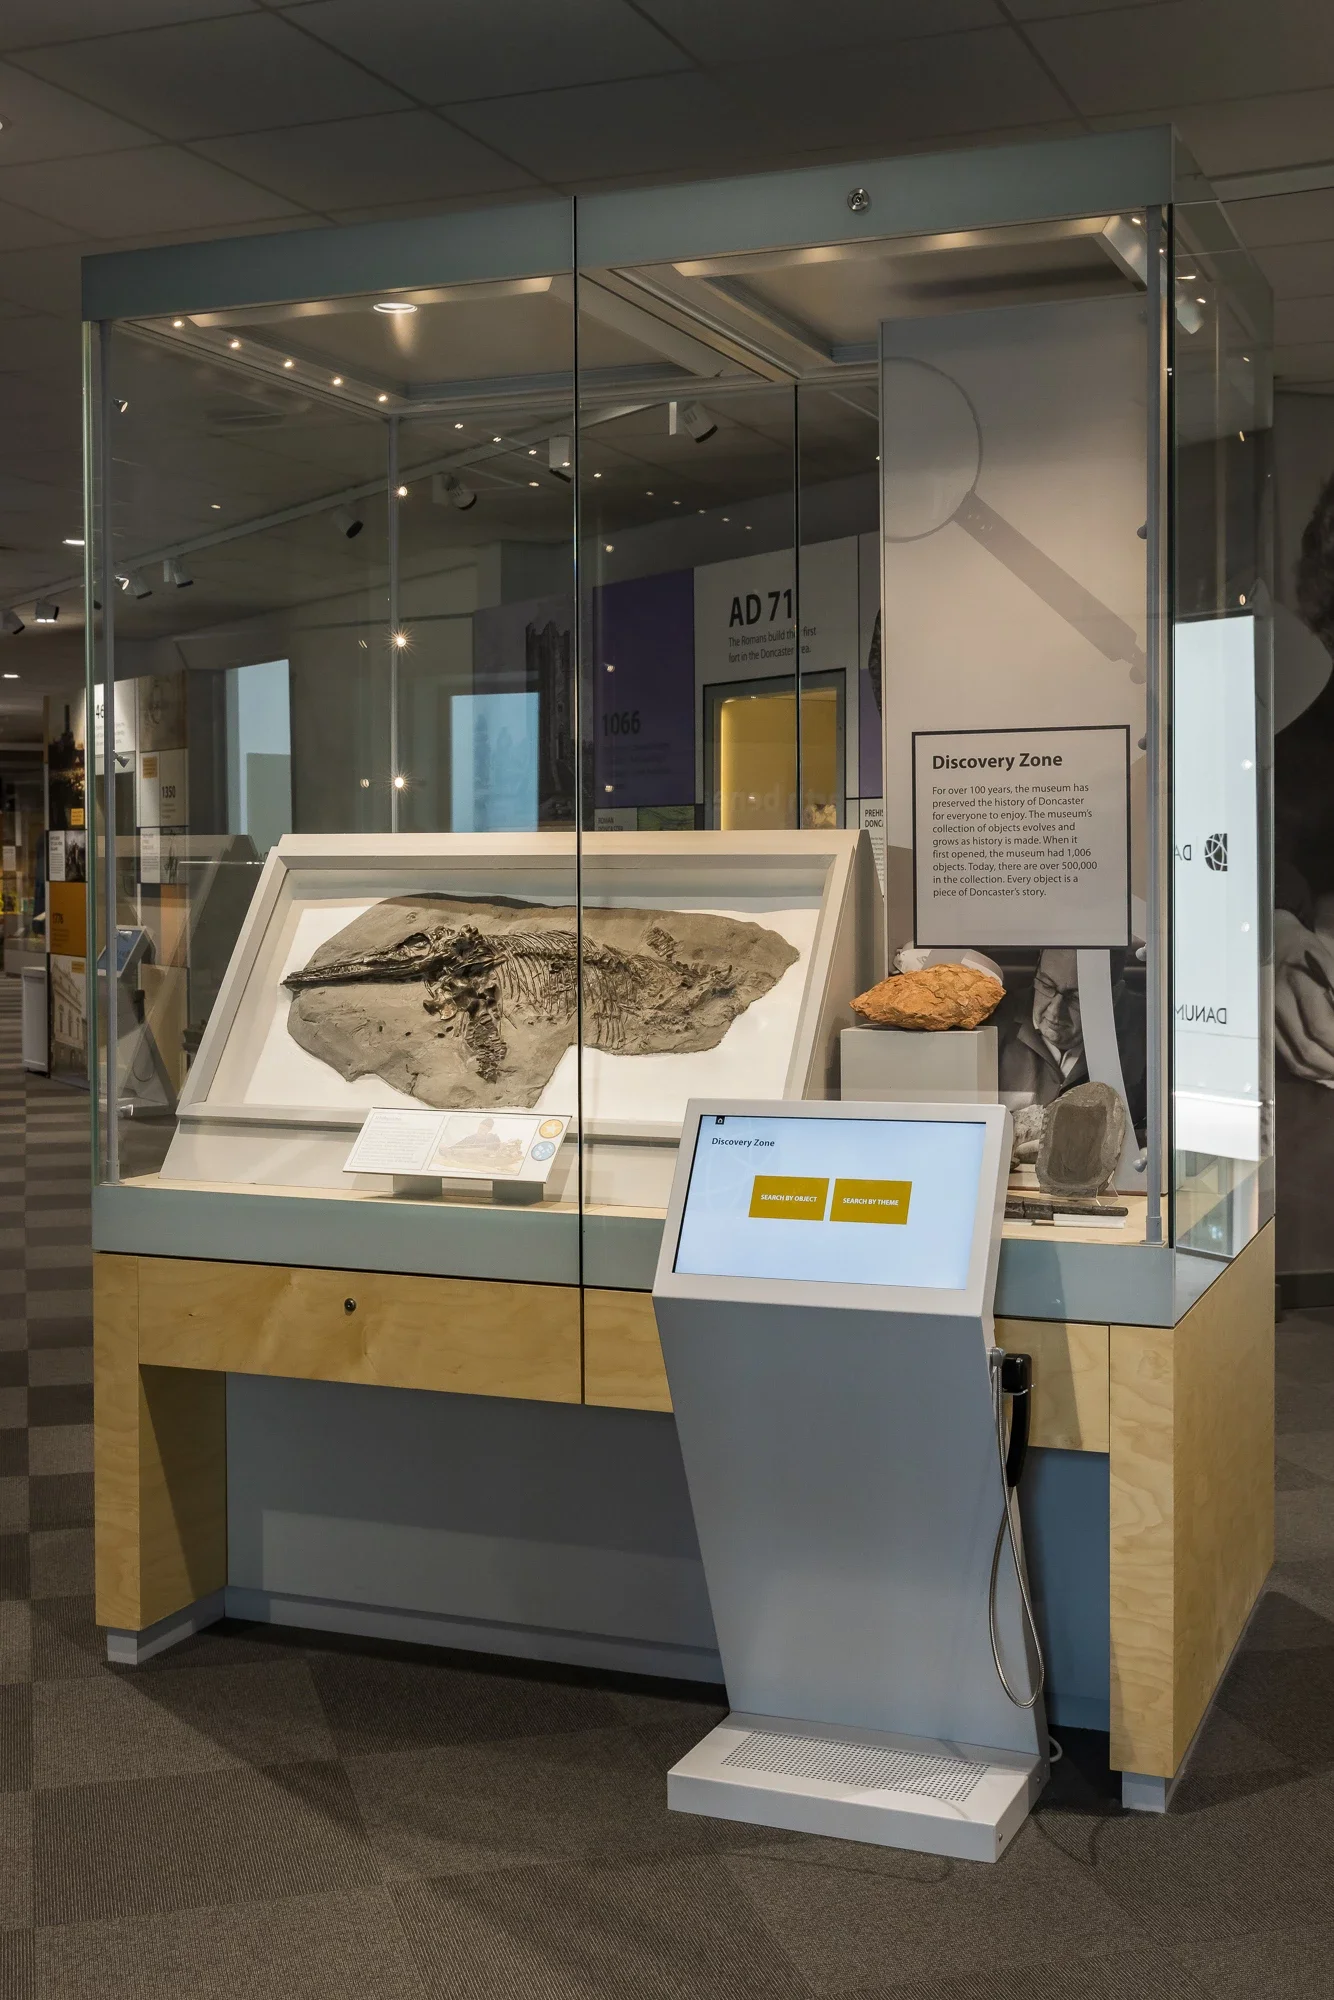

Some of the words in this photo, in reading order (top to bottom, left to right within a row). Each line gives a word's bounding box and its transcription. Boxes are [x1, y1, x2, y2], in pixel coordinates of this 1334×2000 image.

[729, 594, 761, 627] AD
[768, 589, 792, 621] 71
[729, 638, 740, 647] The
[742, 634, 766, 646] Romans
[768, 630, 785, 642] build
[804, 626, 816, 636] first
[729, 653, 740, 662] fort
[741, 653, 748, 661] in
[749, 650, 759, 660] the
[761, 646, 794, 658] Doncaster
[601, 711, 640, 736] 1066
[932, 755, 1015, 771] Discovery
[1019, 753, 1063, 767] Zone
[162, 785, 176, 799] 1350
[932, 787, 946, 795] For
[948, 787, 967, 795] over
[970, 786, 986, 794] 100
[988, 786, 1013, 795] years,
[1015, 785, 1029, 793] the
[1032, 785, 1070, 793] museum
[1073, 784, 1089, 792] has
[932, 799, 975, 809] preserved
[978, 798, 992, 807] the
[994, 798, 1025, 807] history
[1027, 797, 1037, 806] of
[1039, 797, 1084, 805] Doncaster
[932, 812, 945, 821] for
[947, 812, 987, 822] everyone
[989, 811, 998, 819] to
[1001, 811, 1027, 821] enjoy.
[1029, 810, 1045, 819] The
[1048, 809, 1093, 818] museum’s
[933, 825, 975, 833] collection
[977, 824, 987, 832] of
[988, 823, 1020, 834] objects
[1022, 823, 1056, 832] evolves
[1058, 822, 1075, 831] and
[933, 837, 959, 848] grows
[961, 837, 970, 846] as
[972, 837, 1002, 847] history
[1005, 836, 1012, 845] is
[1014, 835, 1041, 845] made.
[1043, 835, 1068, 844] When
[1071, 836, 1077, 844] it
[933, 850, 949, 858] first
[951, 849, 988, 860] opened,
[989, 849, 1004, 858] the
[1006, 849, 1045, 857] museum
[1047, 848, 1065, 857] had
[1067, 849, 1091, 858] 1,006
[933, 862, 967, 873] objects.
[968, 862, 997, 872] Today,
[998, 862, 1022, 871] there
[1024, 862, 1037, 870] are
[1040, 862, 1060, 870] over
[1062, 861, 1097, 872] 500,000
[933, 875, 941, 883] in
[944, 874, 958, 883] the
[960, 875, 1005, 884] collection.
[1007, 875, 1031, 885] Every
[1033, 874, 1062, 885] object
[1064, 874, 1071, 883] is
[933, 888, 957, 898] piece
[959, 887, 968, 896] of
[970, 887, 1020, 896] Doncaster’s
[1022, 887, 1047, 897] story.
[712, 1138, 752, 1148] Discovery
[754, 1139, 775, 1147] Zone
